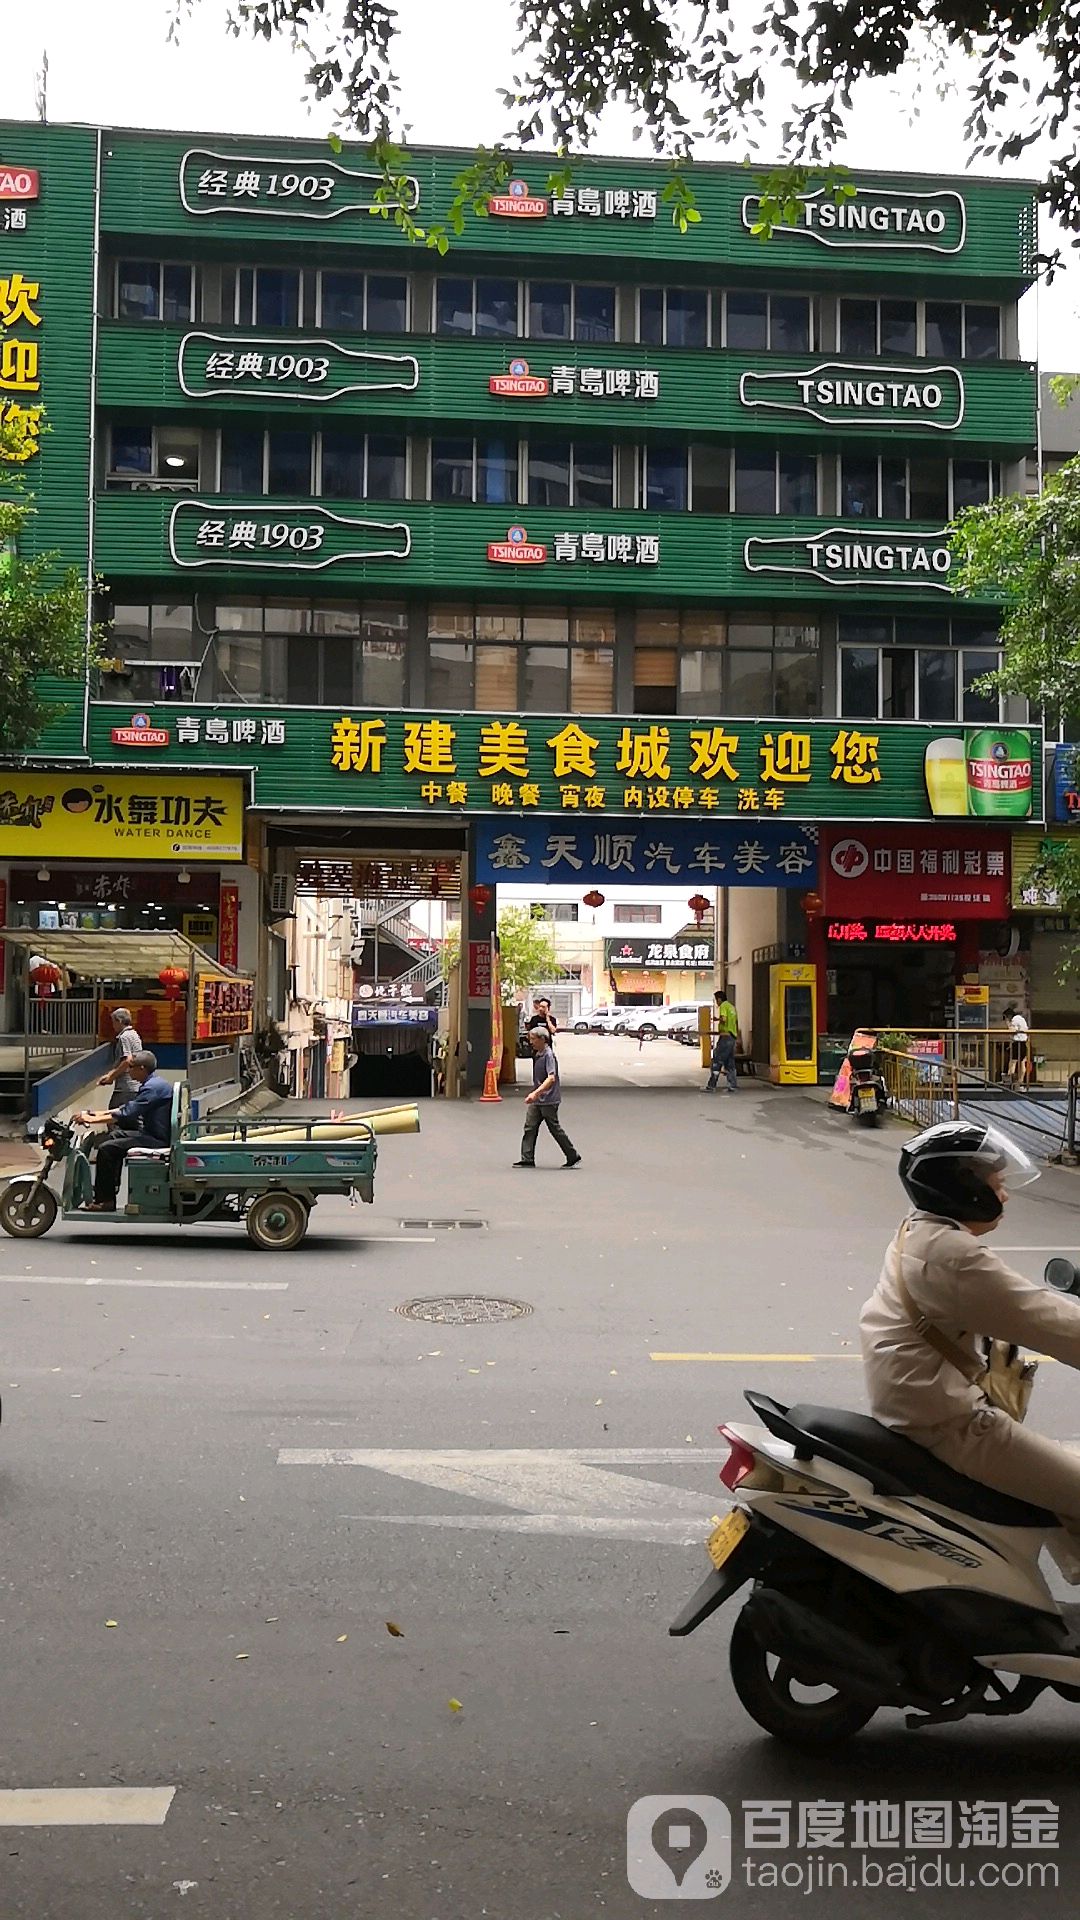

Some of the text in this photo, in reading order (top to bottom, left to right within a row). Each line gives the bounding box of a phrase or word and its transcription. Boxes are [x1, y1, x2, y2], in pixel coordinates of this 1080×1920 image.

[492, 199, 545, 214] TSINGTAO
[551, 188, 657, 220] 青岛啤酒
[803, 202, 946, 234] TSINGTAO
[492, 379, 545, 394] TSINGTAO
[551, 366, 659, 399] 青岛啤酒
[798, 379, 942, 409] TSINGTAO
[491, 545, 544, 560] TSINGTAO
[553, 532, 660, 565] 青岛啤酒
[806, 543, 951, 573] TSINGTAO
[115, 730, 166, 743] TSINGTAO
[175, 716, 286, 745] 青岛啤酒
[330, 717, 882, 784] 新建美食城欢迎您
[969, 762, 1032, 779] TSINGTAO
[421, 781, 785, 810] 中餐 晚餐 宵夜 内设停车 洗车
[94, 794, 229, 827] 水舞功夫
[114, 828, 213, 839] WATER DANCE
[487, 833, 813, 875] 鑫天顺汽车美容
[873, 848, 1005, 876] 中国福利彩票
